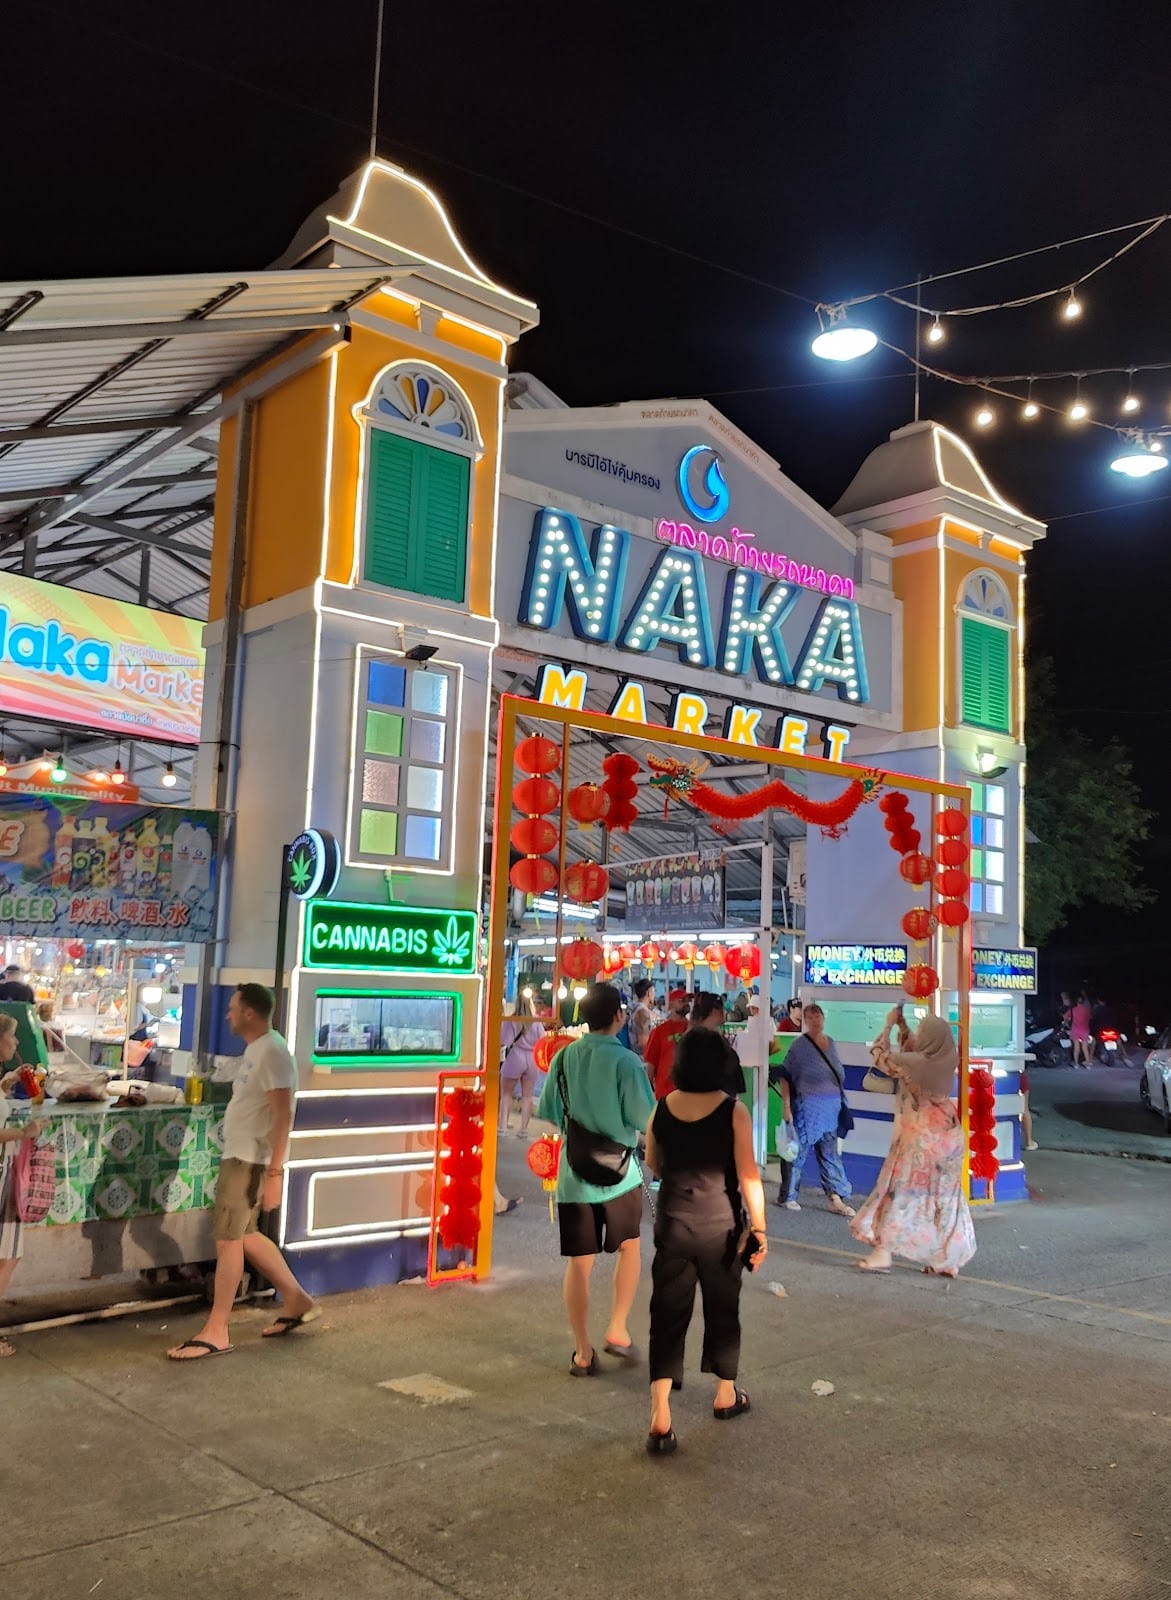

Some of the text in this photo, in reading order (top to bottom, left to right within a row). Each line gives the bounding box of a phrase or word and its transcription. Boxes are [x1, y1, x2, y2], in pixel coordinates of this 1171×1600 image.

[518, 506, 870, 703] NAKA
[116, 658, 204, 704] Marke
[538, 663, 851, 763] MARKET
[1, 899, 56, 920] BEER
[311, 922, 429, 954] CANNABIS
[807, 945, 862, 962] MONEY
[971, 949, 1003, 966] ONEY
[827, 968, 905, 985] EXCHANGE
[976, 973, 1035, 989] EXCHANGE
